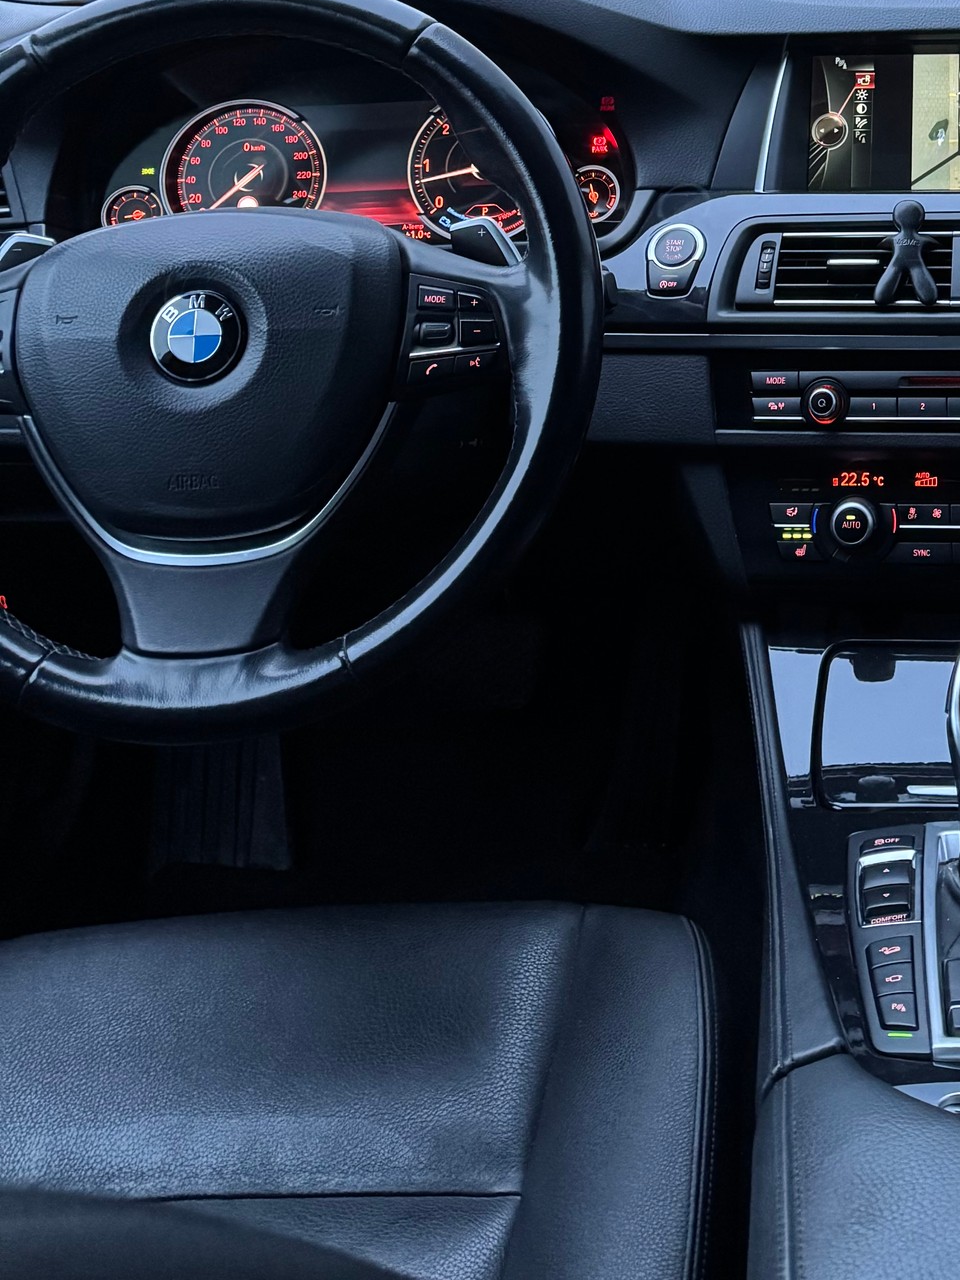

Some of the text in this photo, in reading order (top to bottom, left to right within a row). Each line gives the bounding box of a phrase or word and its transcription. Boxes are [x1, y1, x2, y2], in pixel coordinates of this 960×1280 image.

[442, 124, 450, 135] 2
[200, 140, 211, 148] 80
[244, 142, 250, 151] 0
[592, 146, 608, 154] PARK
[294, 152, 308, 160] 200
[423, 158, 430, 172] 1
[296, 170, 312, 178] 220
[186, 176, 196, 184] 40
[188, 194, 202, 203] 20
[435, 196, 444, 208] 0
[482, 207, 488, 216] P
[424, 295, 446, 304] MODE
[161, 294, 232, 323] BMW
[872, 402, 876, 410] 1
[920, 402, 925, 410] 2
[167, 474, 219, 491] AIRBAG
[840, 472, 870, 486] 22.5
[870, 914, 908, 924] COMFORT
